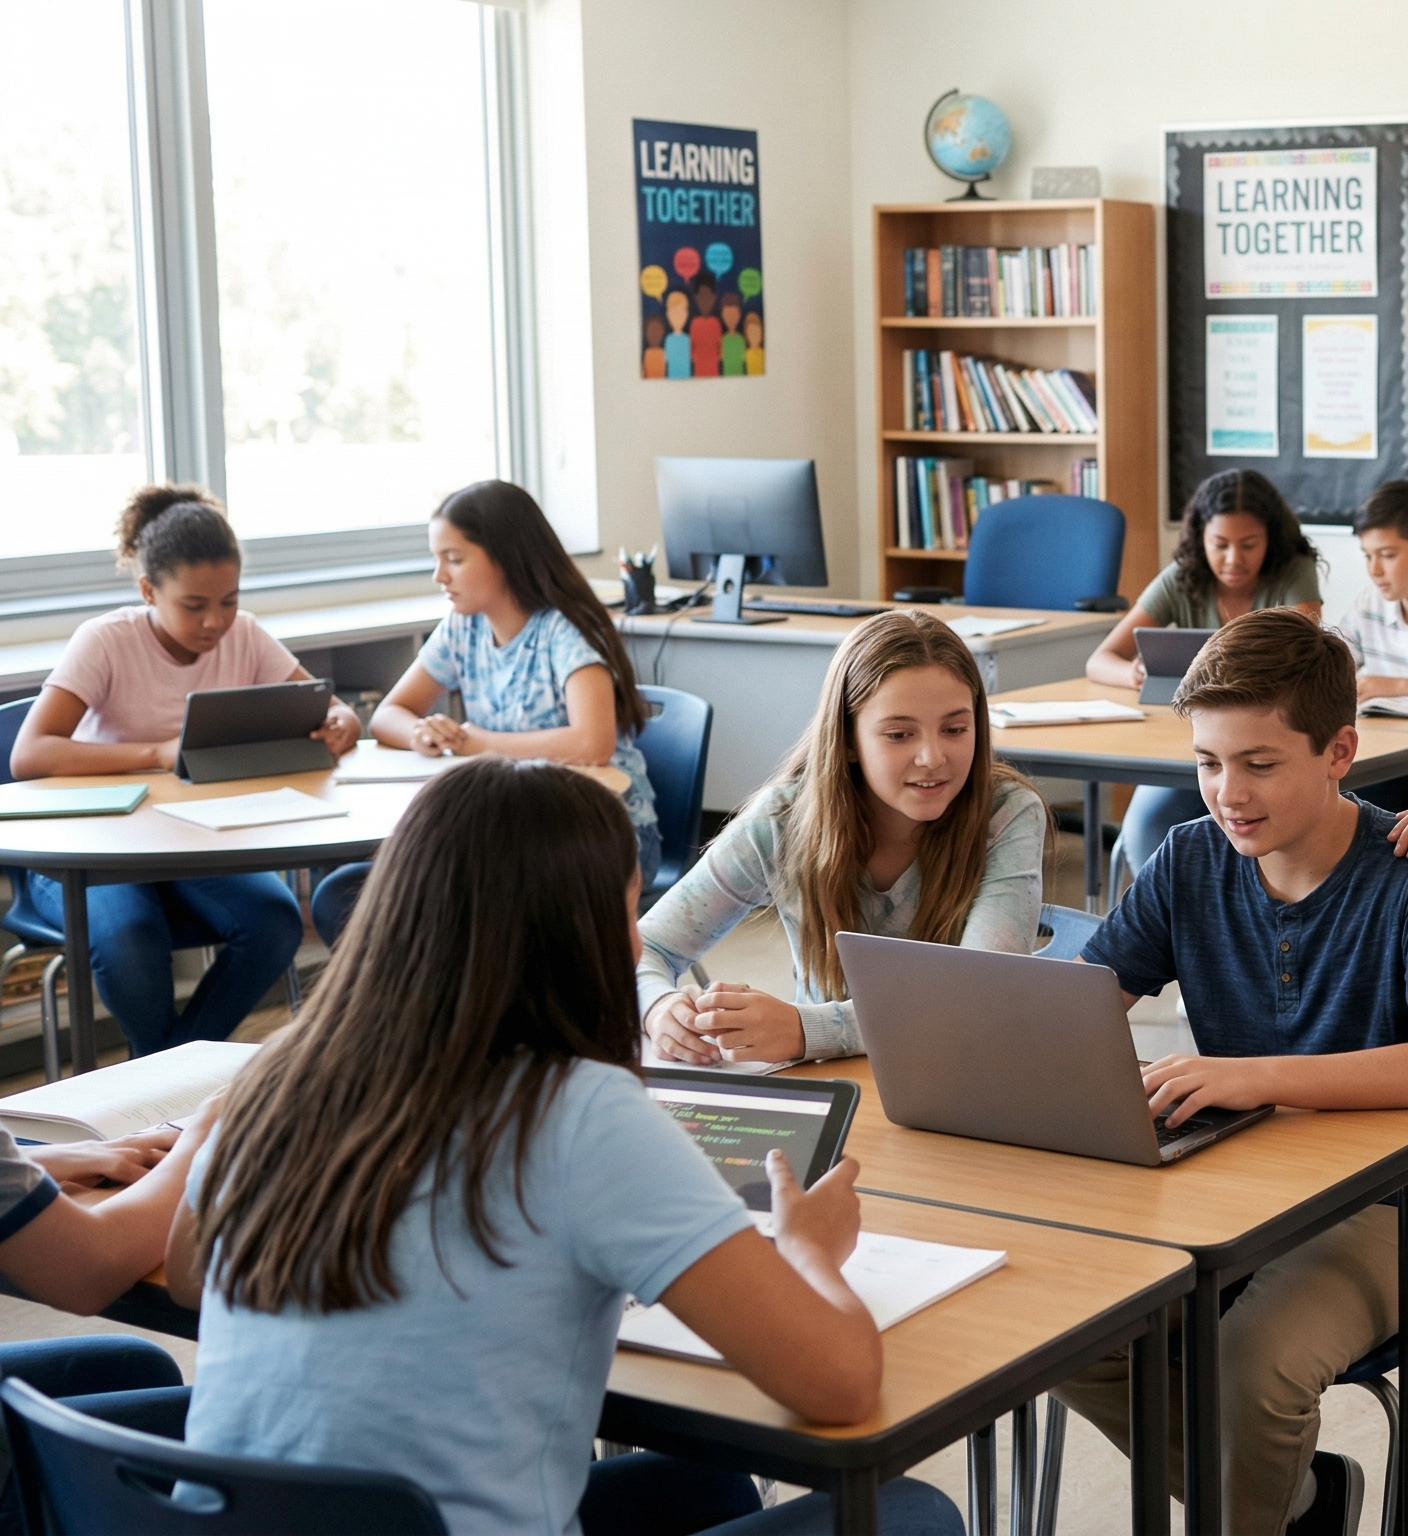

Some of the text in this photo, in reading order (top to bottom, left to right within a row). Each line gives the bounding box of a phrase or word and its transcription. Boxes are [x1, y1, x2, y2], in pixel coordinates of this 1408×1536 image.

[640, 140, 755, 185] LEARNING
[641, 185, 755, 227] TOGETHER
[1217, 177, 1364, 213] LEARNING
[1217, 220, 1364, 255] TOGETHER
